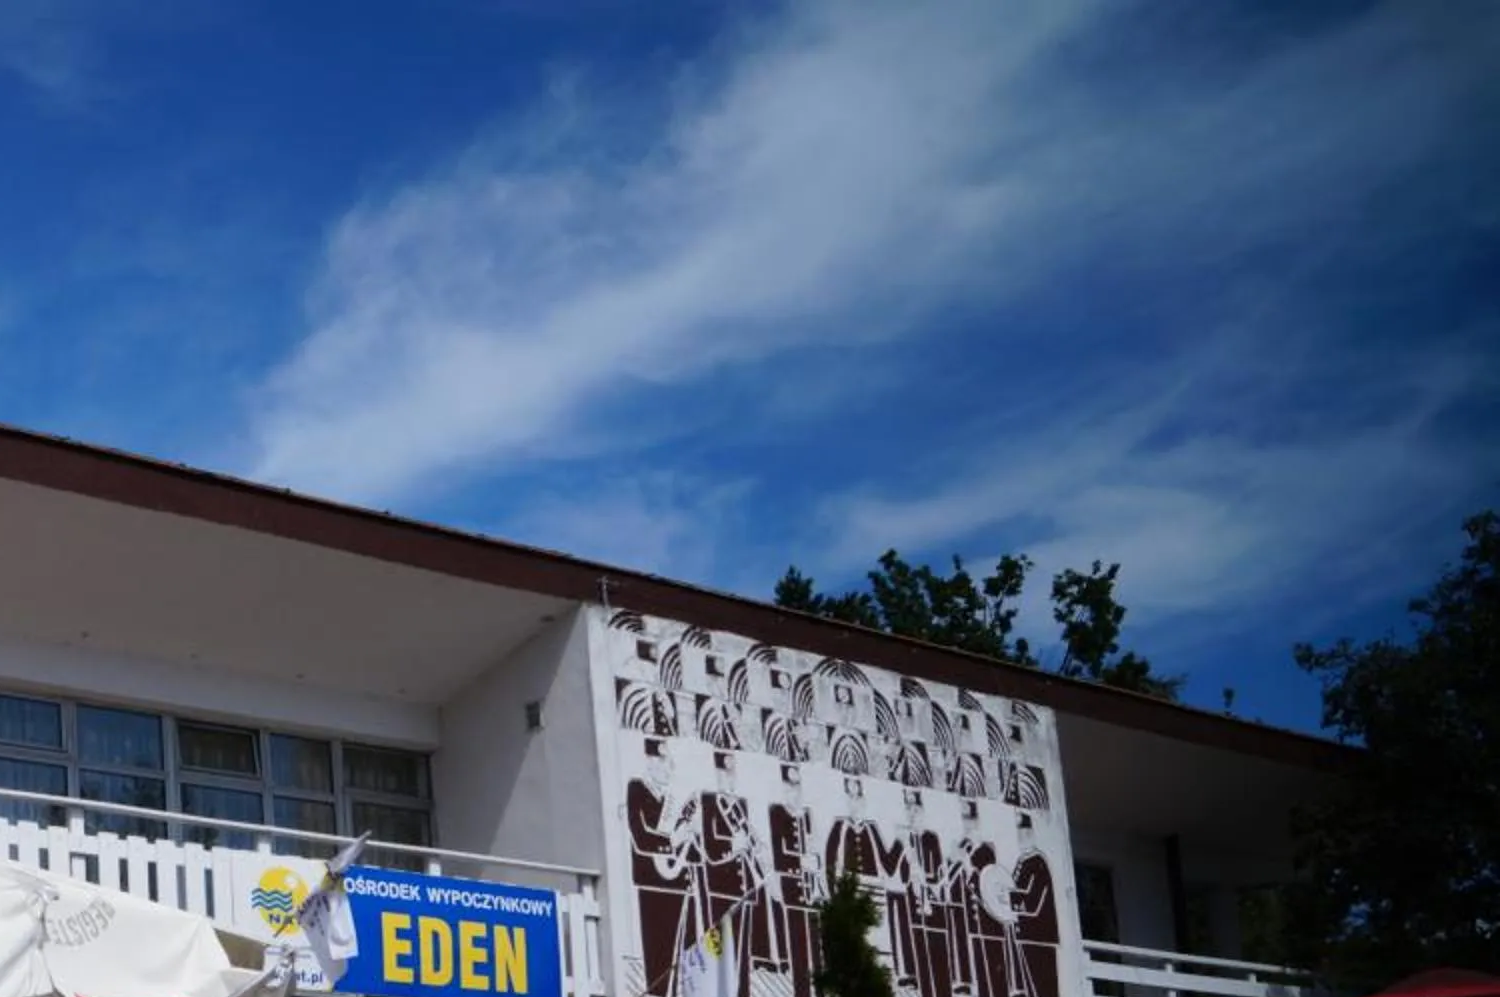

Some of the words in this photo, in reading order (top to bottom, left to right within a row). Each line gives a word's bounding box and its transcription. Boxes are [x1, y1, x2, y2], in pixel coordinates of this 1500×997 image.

[343, 876, 421, 901] OŚRODEK
[426, 887, 553, 917] WYPOCZYNKOWY
[381, 911, 529, 995] EDEN
